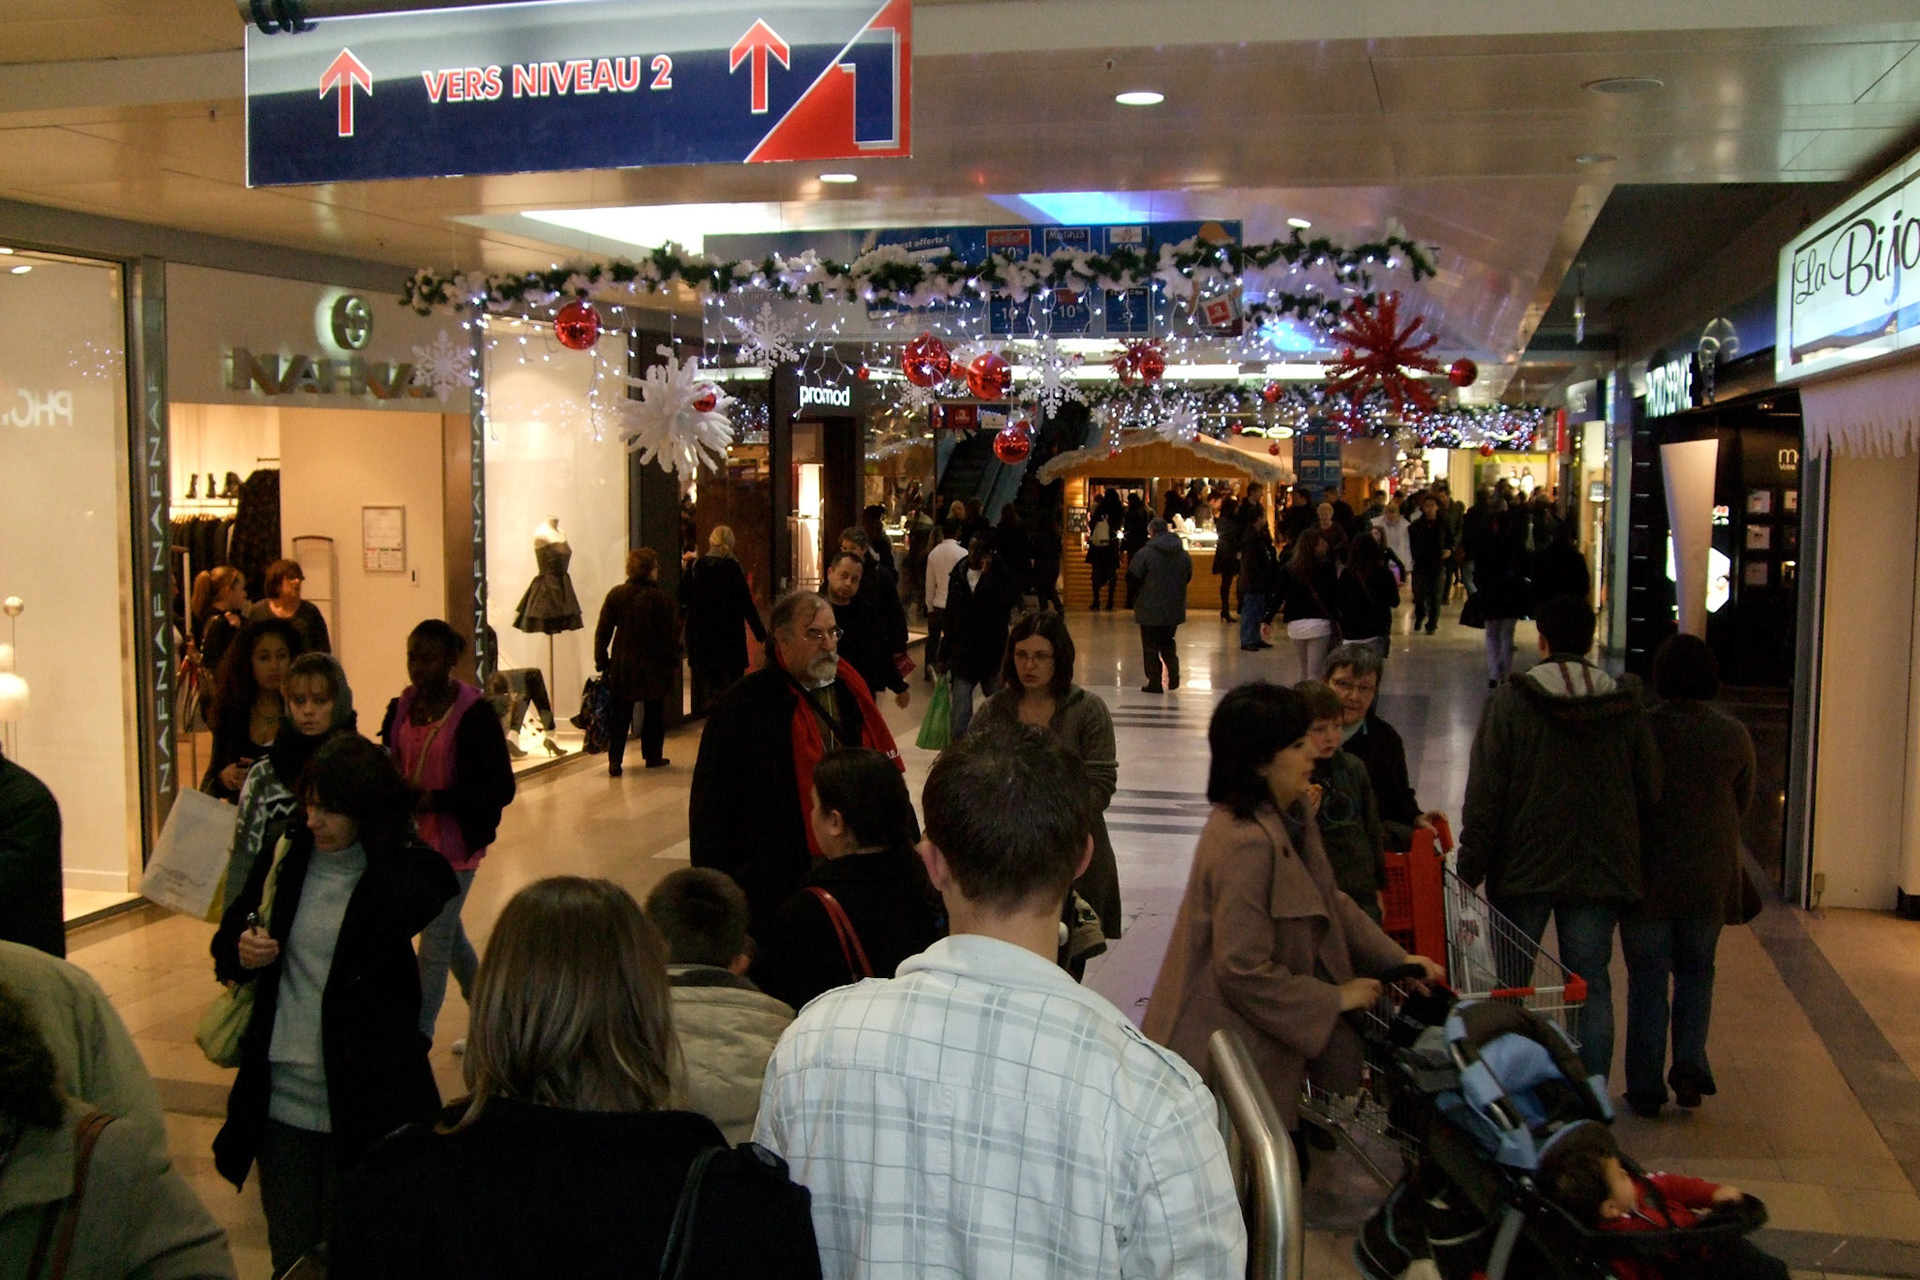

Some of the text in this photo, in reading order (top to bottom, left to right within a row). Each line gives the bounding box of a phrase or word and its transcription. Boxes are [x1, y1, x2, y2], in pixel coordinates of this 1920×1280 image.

[422, 54, 673, 103] VERS NIVEAU 2
[1795, 248, 1827, 305] La
[799, 385, 850, 407] promod
